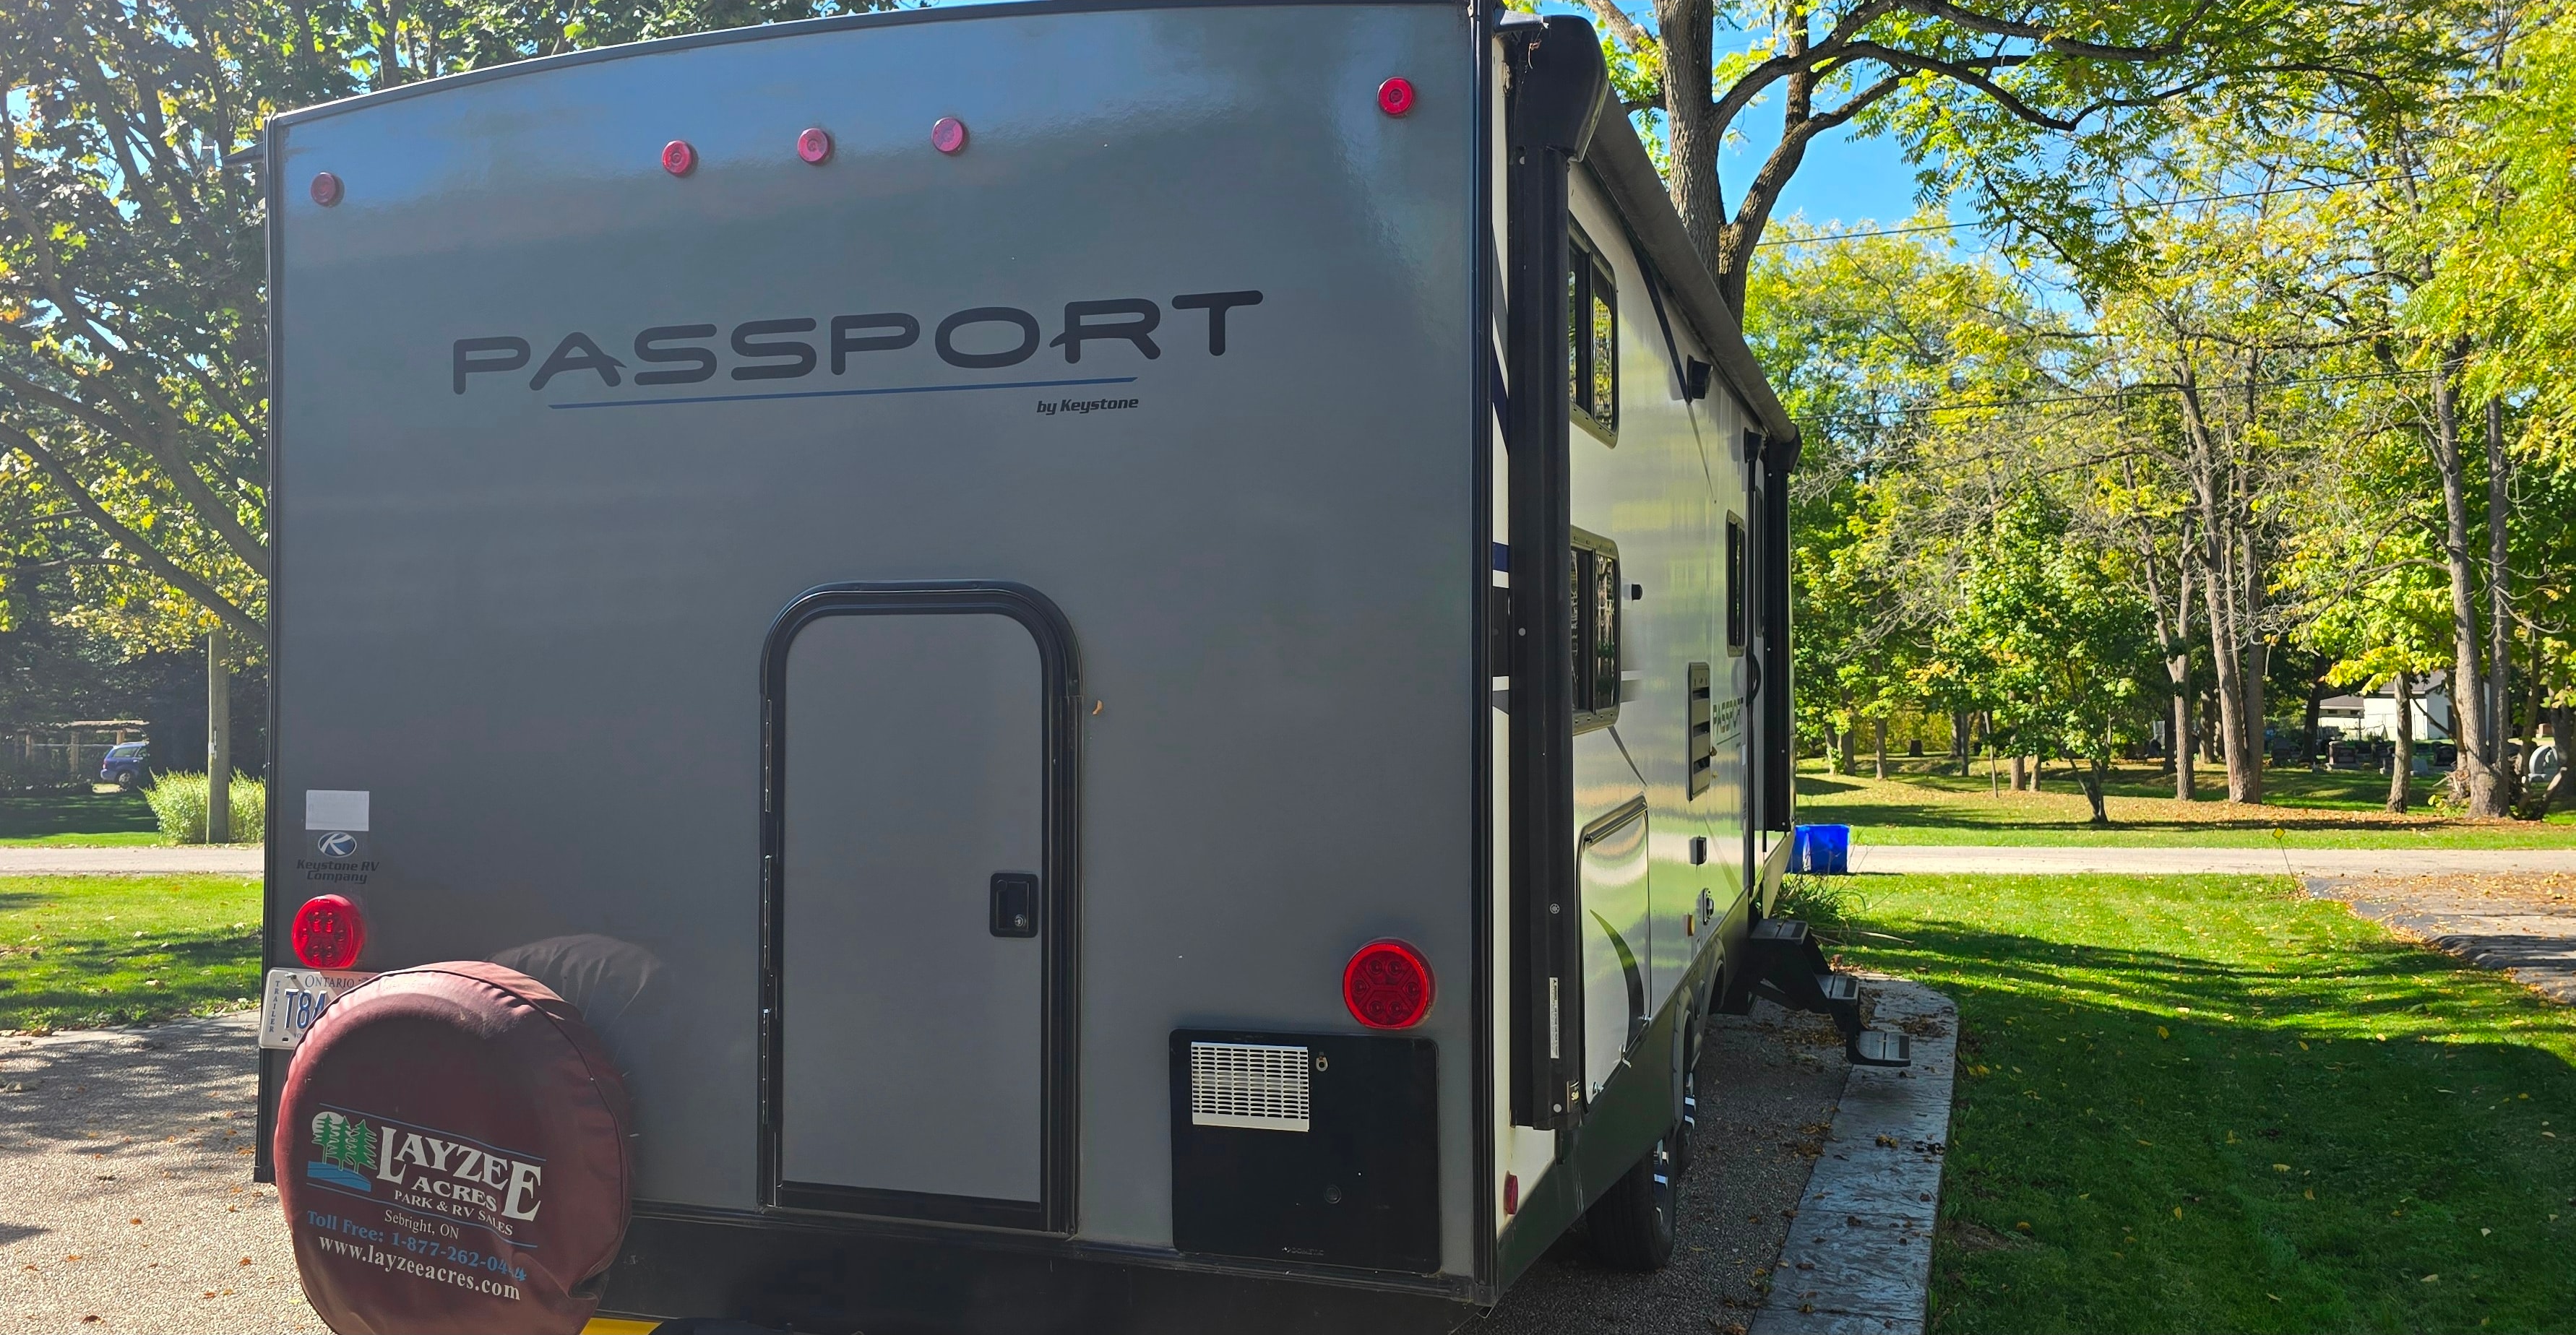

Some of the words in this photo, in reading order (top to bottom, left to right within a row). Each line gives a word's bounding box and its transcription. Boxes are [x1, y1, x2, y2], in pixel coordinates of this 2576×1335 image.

[454, 290, 1263, 394] PASSPORT
[1036, 401, 1057, 415] by
[1060, 399, 1139, 414] Keystone
[296, 860, 358, 871] Keystone
[361, 861, 379, 871] RV
[307, 870, 367, 884] Company
[269, 981, 280, 1032] TRAILER
[376, 1126, 541, 1222] LAYZEE
[411, 1176, 497, 1212] ACRES
[384, 1209, 435, 1236] Sebright,
[440, 1223, 459, 1240] ON
[395, 1190, 433, 1209] PARK
[436, 1201, 448, 1211] &
[452, 1204, 474, 1217] RV
[478, 1210, 513, 1235] SALES
[307, 1210, 337, 1230] Toll
[343, 1219, 384, 1243] Free:
[392, 1232, 527, 1282] 1-877-262-044
[319, 1236, 520, 1300] www.layzeeacres.com
